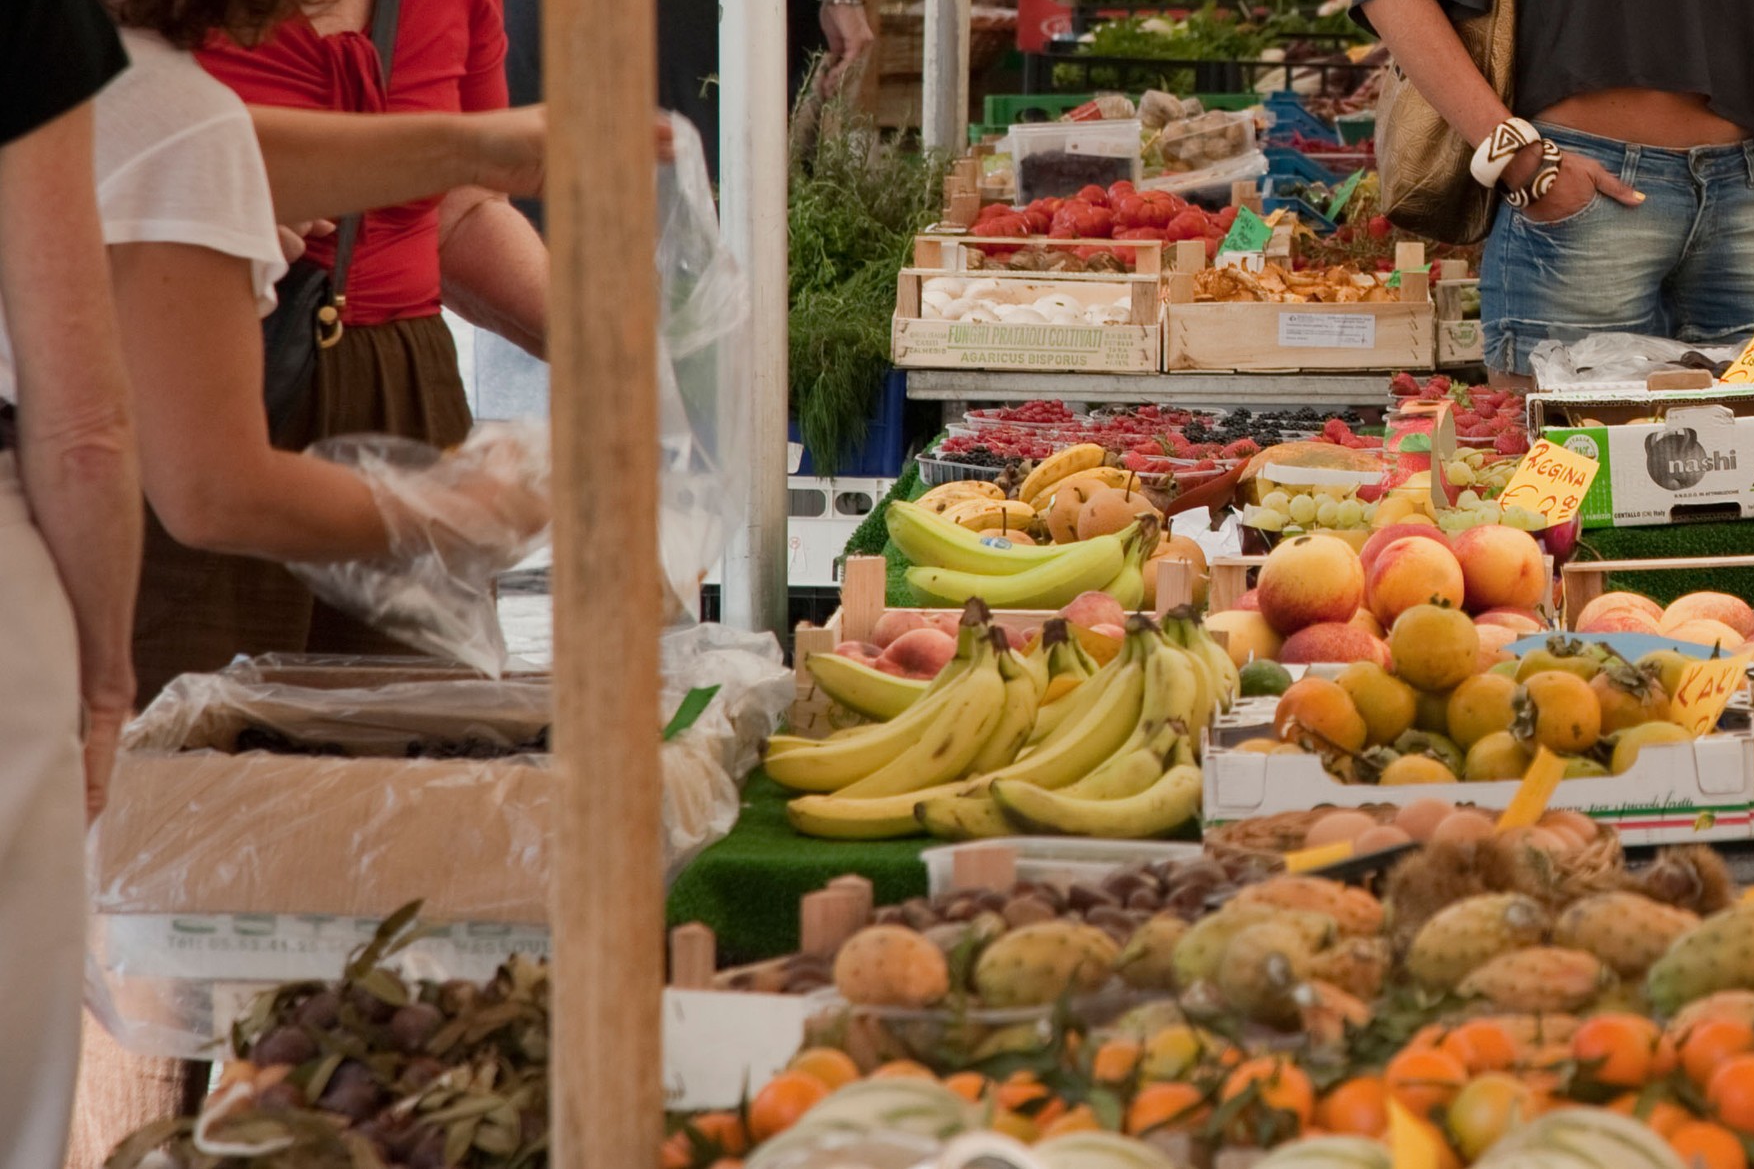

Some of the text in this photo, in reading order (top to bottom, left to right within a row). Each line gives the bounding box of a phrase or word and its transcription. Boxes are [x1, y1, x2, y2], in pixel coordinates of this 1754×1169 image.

[949, 324, 989, 345] FUNGHI
[960, 352, 1088, 366] AGARICUS BISPORUS
[1526, 443, 1586, 487] REGINA
[1668, 449, 1737, 474] nashi
